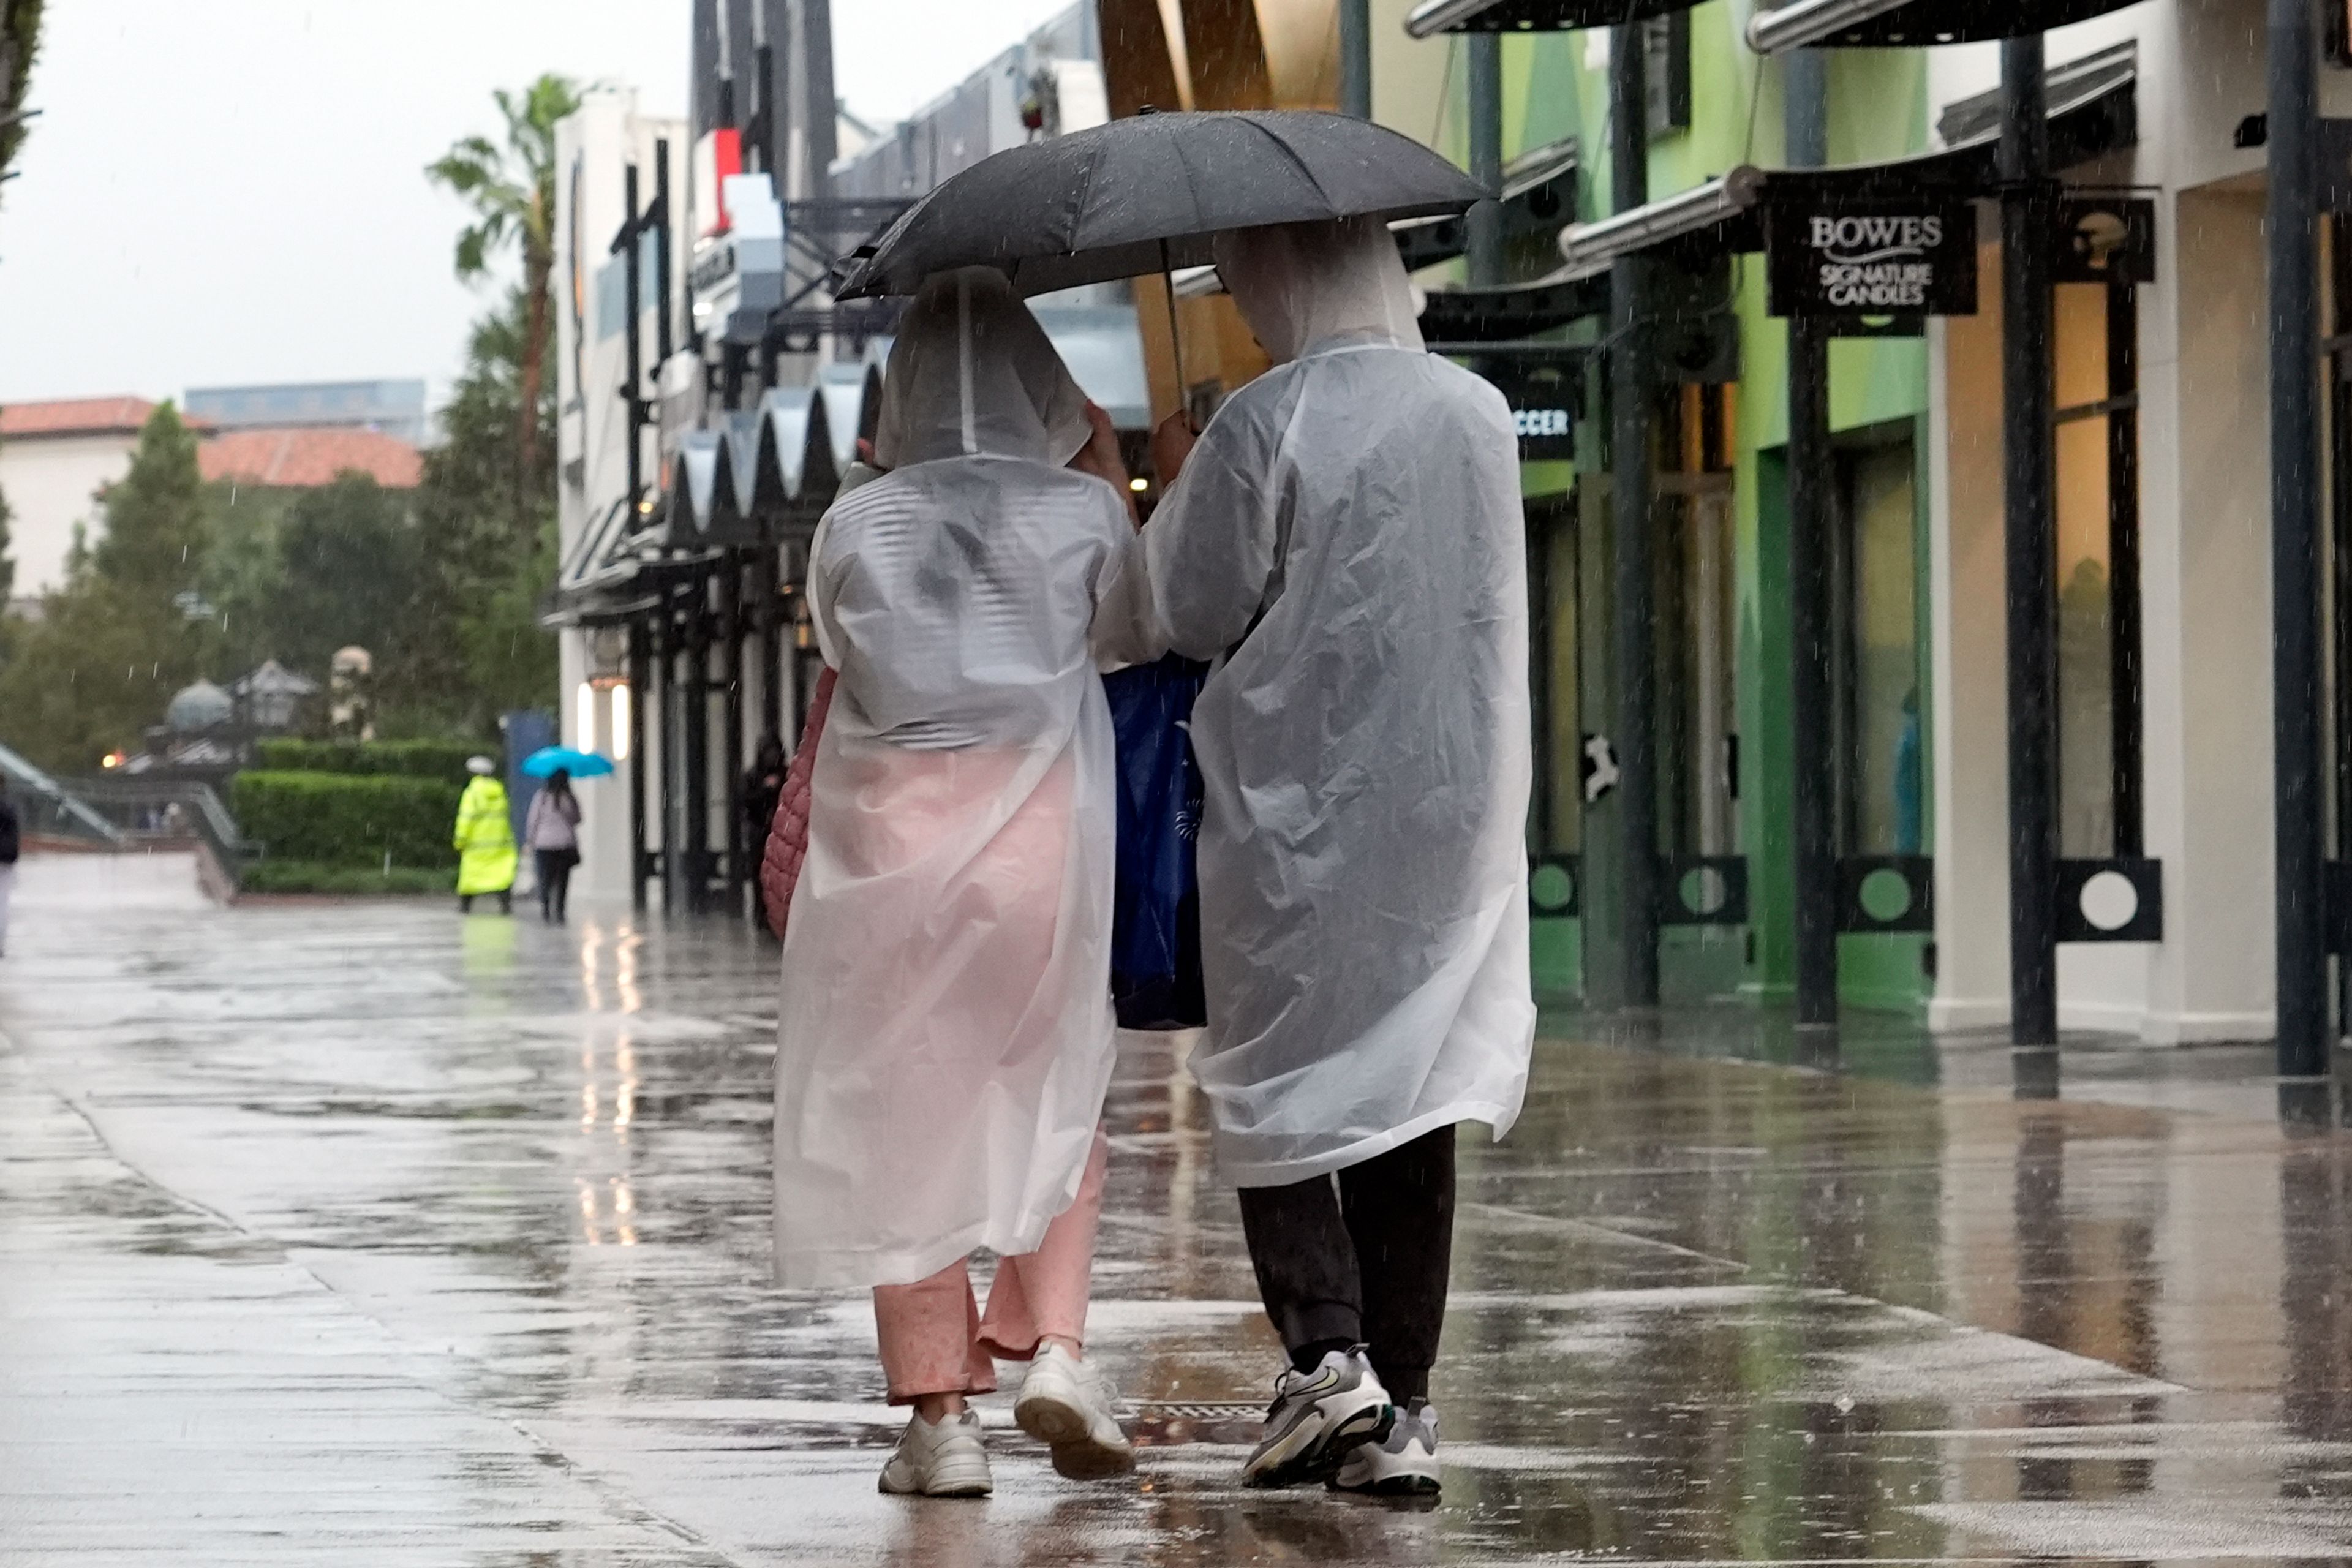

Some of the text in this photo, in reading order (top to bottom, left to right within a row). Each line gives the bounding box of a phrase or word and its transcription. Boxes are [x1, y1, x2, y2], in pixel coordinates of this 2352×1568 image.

[1809, 216, 1942, 247] BOWES
[1819, 263, 1934, 286] SIGNATURE
[1828, 284, 1925, 306] CANDLES
